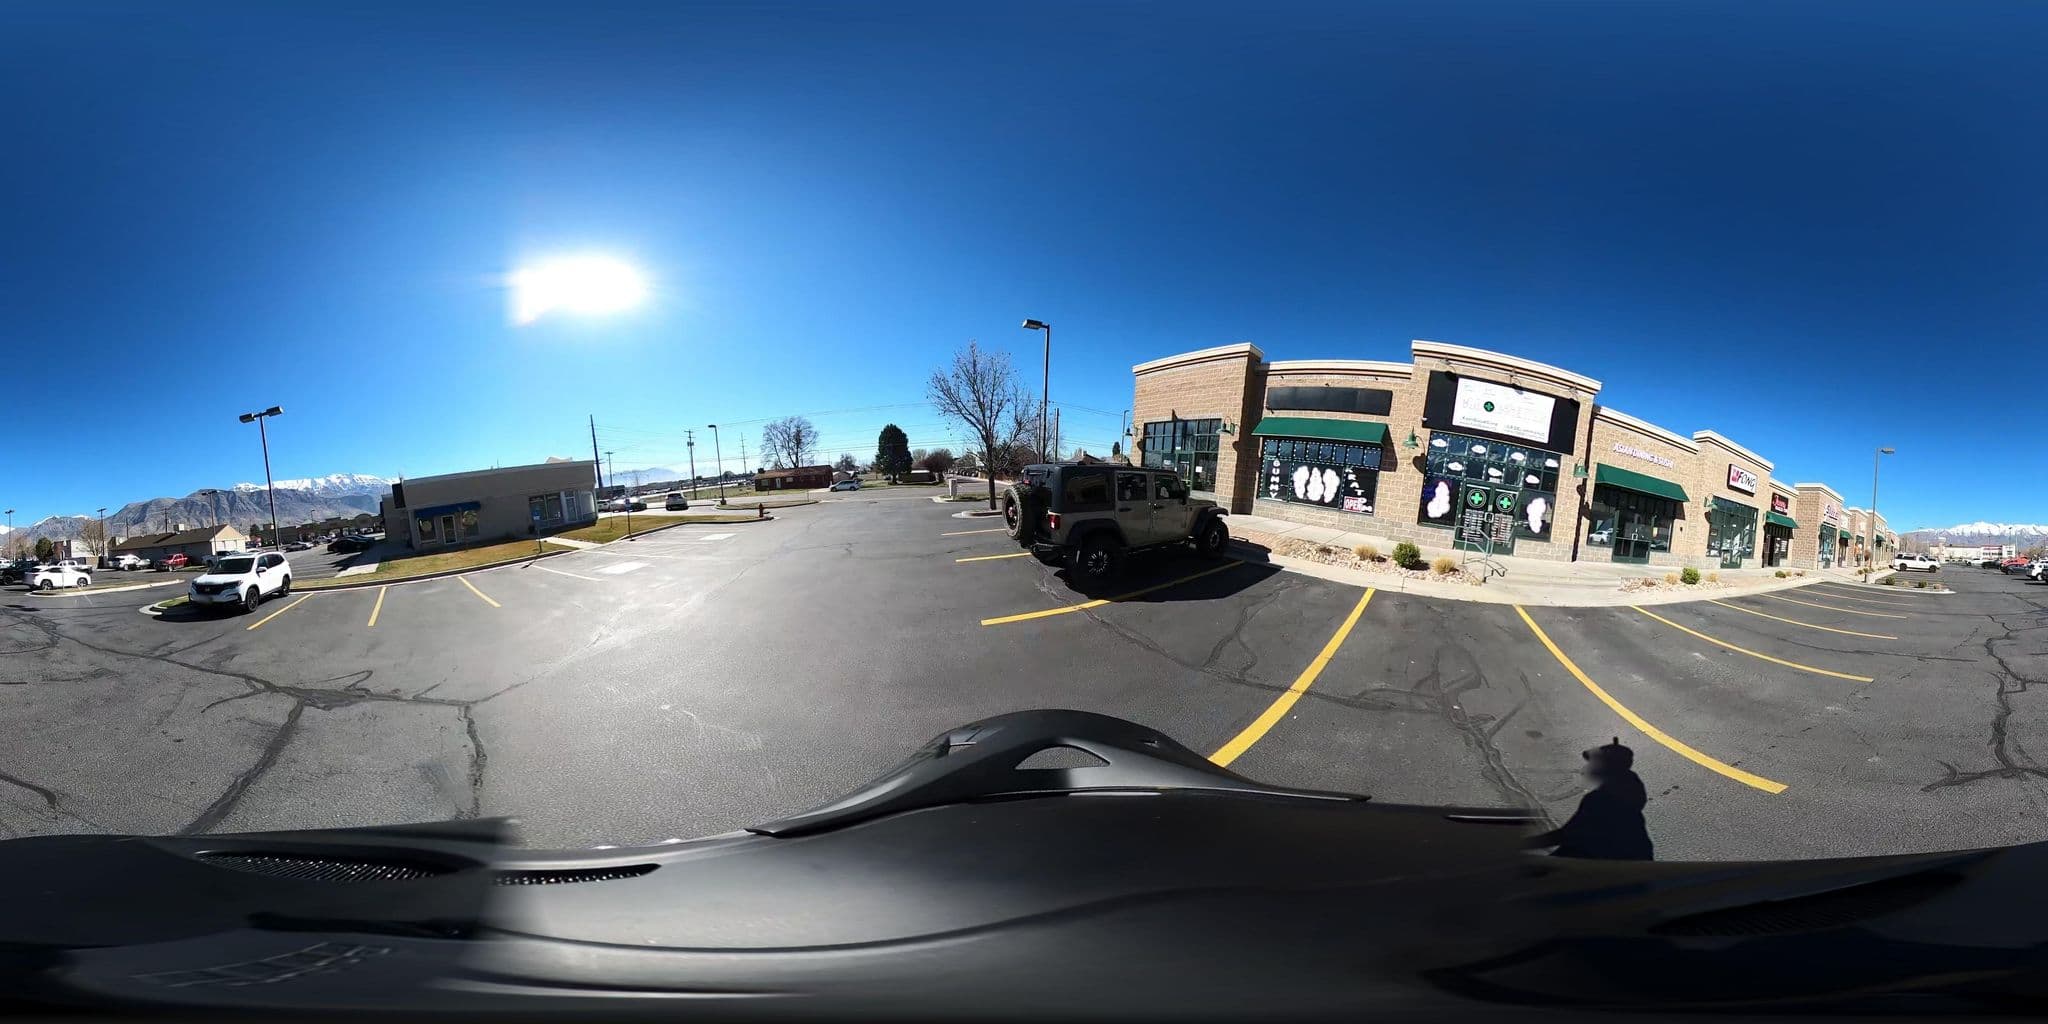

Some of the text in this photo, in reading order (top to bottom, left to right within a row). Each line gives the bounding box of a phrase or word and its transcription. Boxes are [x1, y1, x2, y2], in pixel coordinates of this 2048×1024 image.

[1269, 458, 1281, 498] GUMMY
[1736, 471, 1756, 491] FONG
[1345, 498, 1361, 512] OPEN
